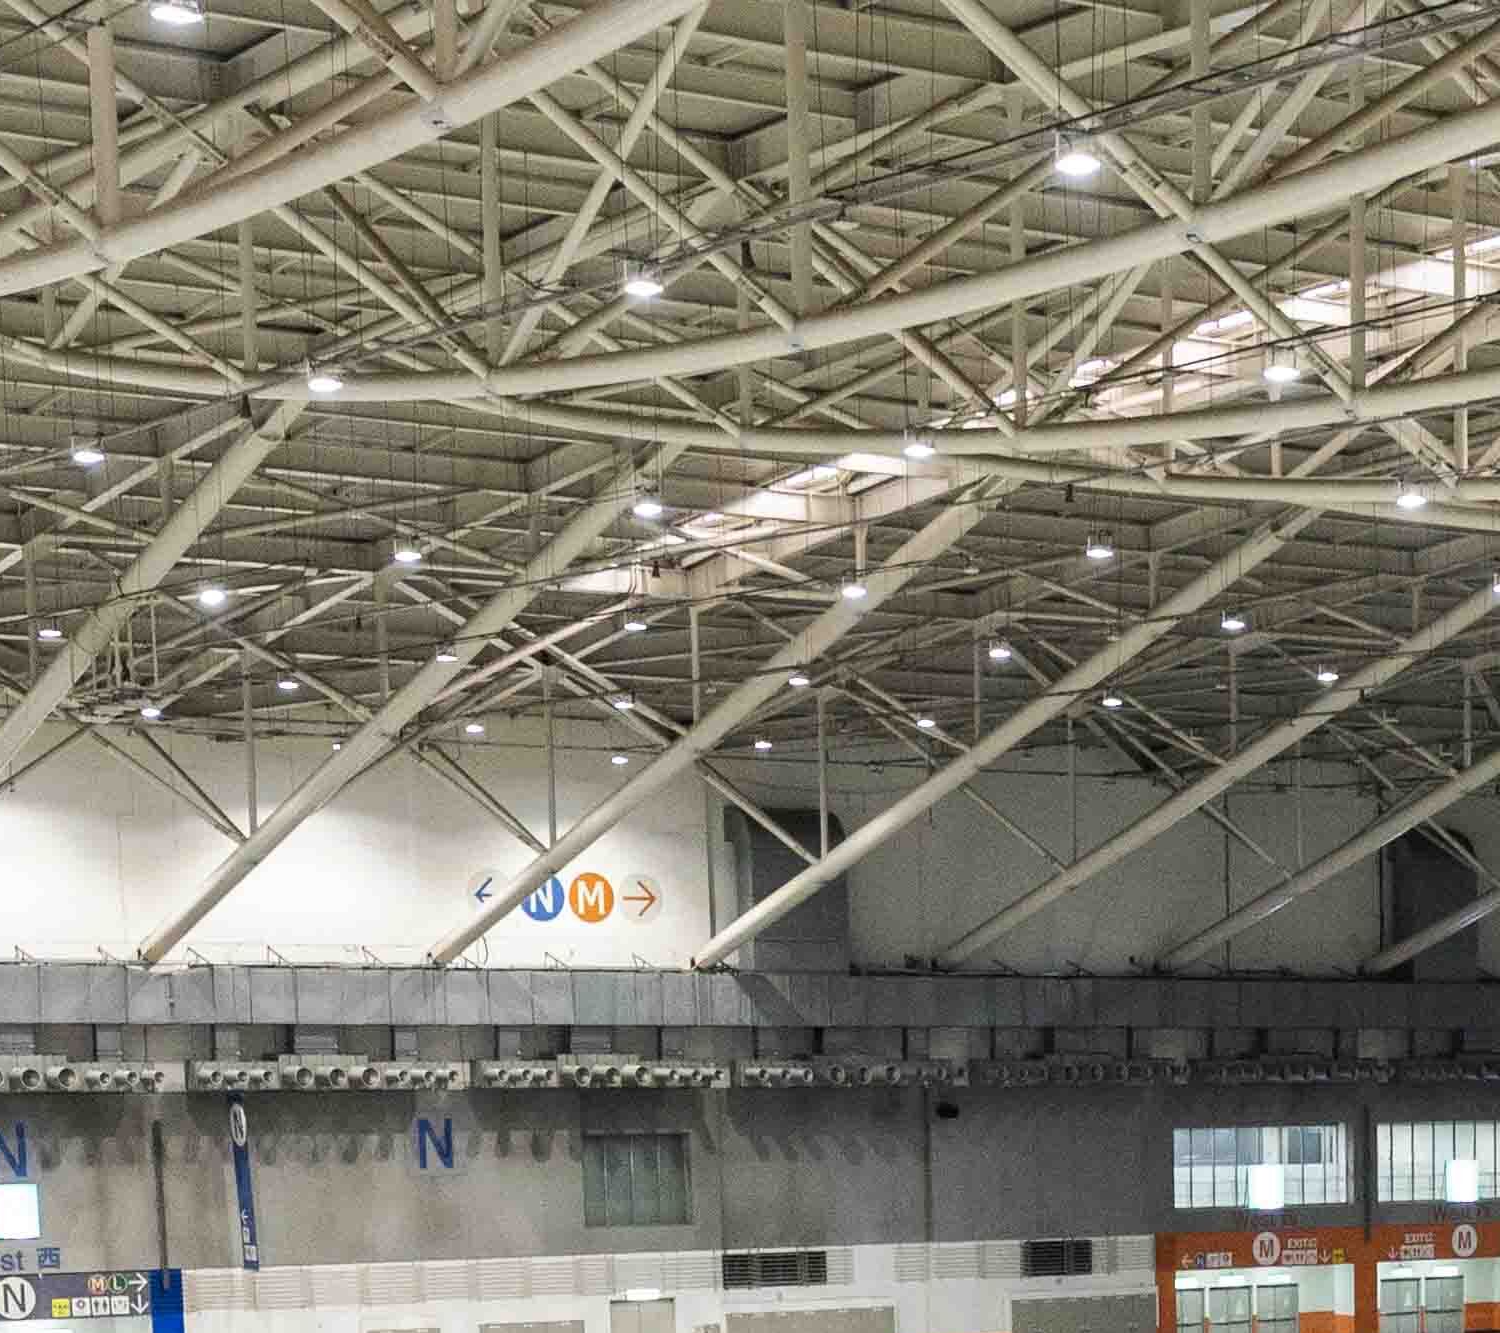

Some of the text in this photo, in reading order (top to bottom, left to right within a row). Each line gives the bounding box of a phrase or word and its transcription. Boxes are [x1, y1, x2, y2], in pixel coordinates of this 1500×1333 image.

[530, 879, 605, 915] N M
[416, 1118, 454, 1169] N
[1259, 1239, 1274, 1257] M
[1458, 1231, 1472, 1250] M
[37, 1247, 60, 1269] 西
[2, 1283, 26, 1314] N
